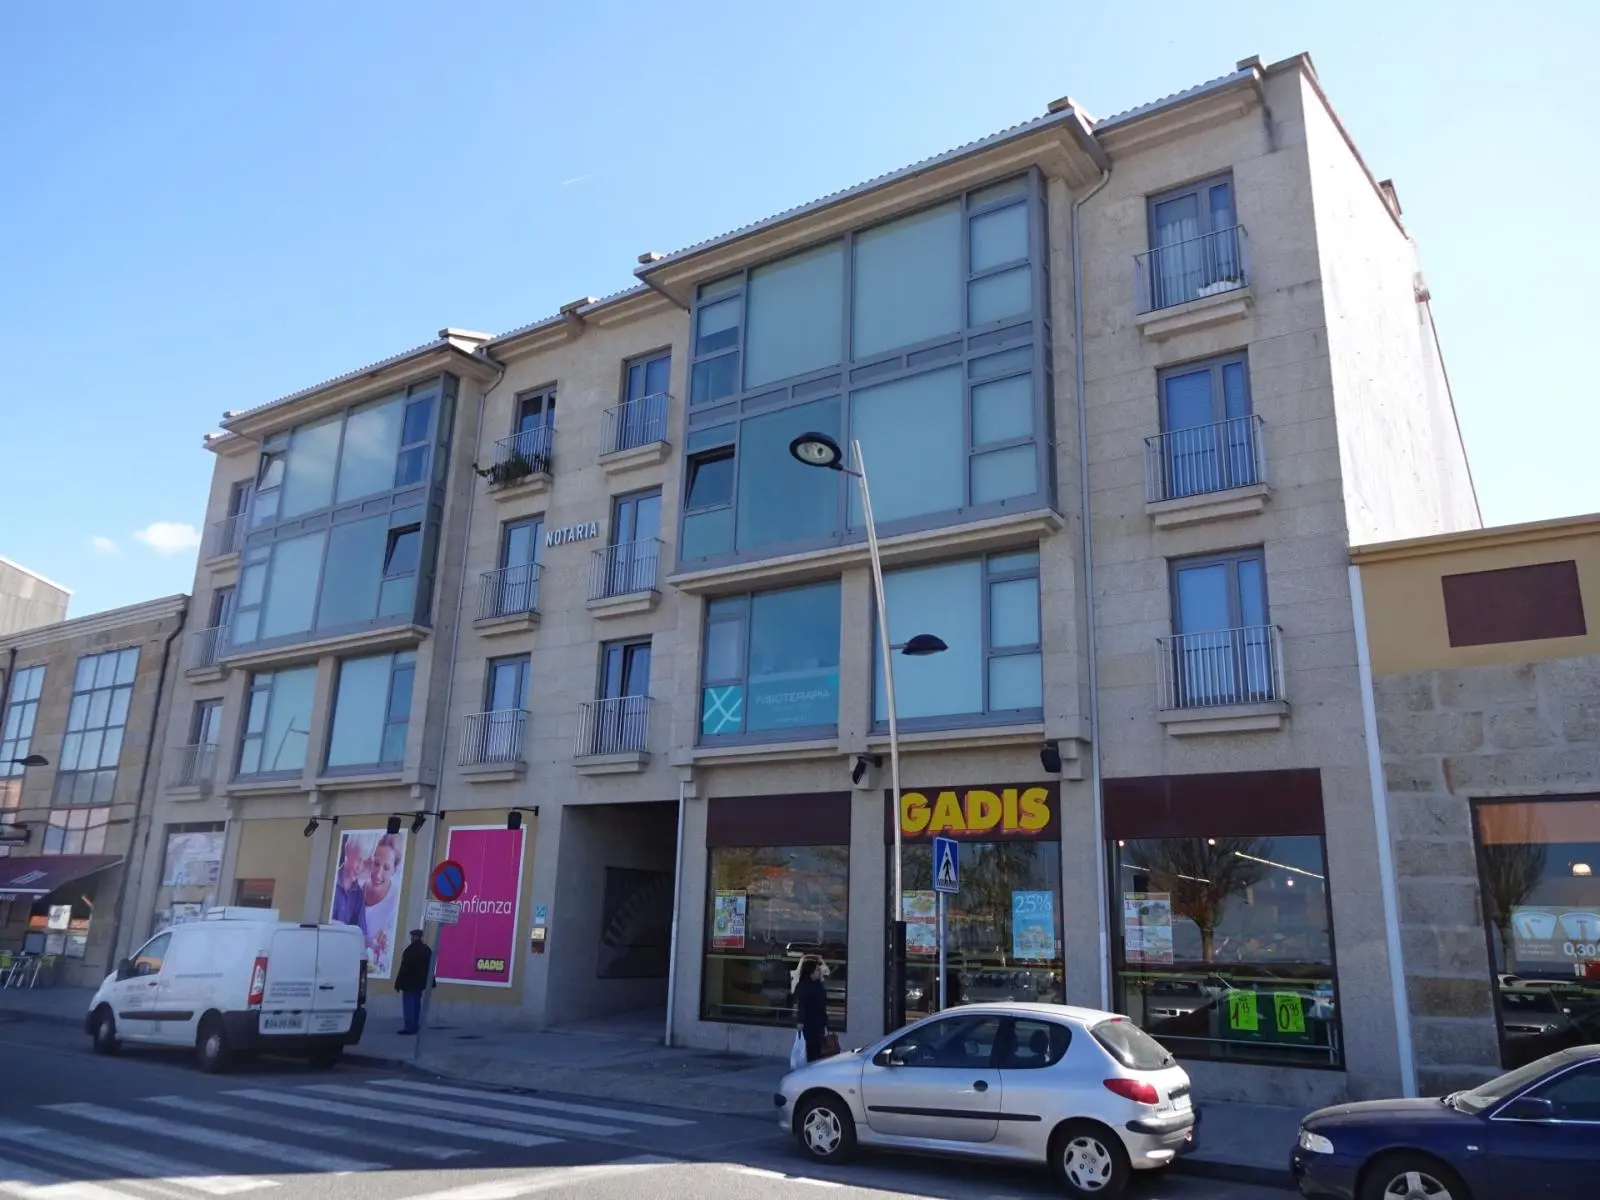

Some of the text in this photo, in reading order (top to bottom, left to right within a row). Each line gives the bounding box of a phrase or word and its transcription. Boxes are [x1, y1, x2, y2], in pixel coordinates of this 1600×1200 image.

[545, 521, 598, 547] NOTARIA
[755, 689, 831, 705] FISIOTERAPIA
[900, 787, 1050, 836] GADIS
[450, 895, 513, 914] onfianza
[1015, 893, 1052, 914] 25%
[477, 959, 505, 971] GADIS
